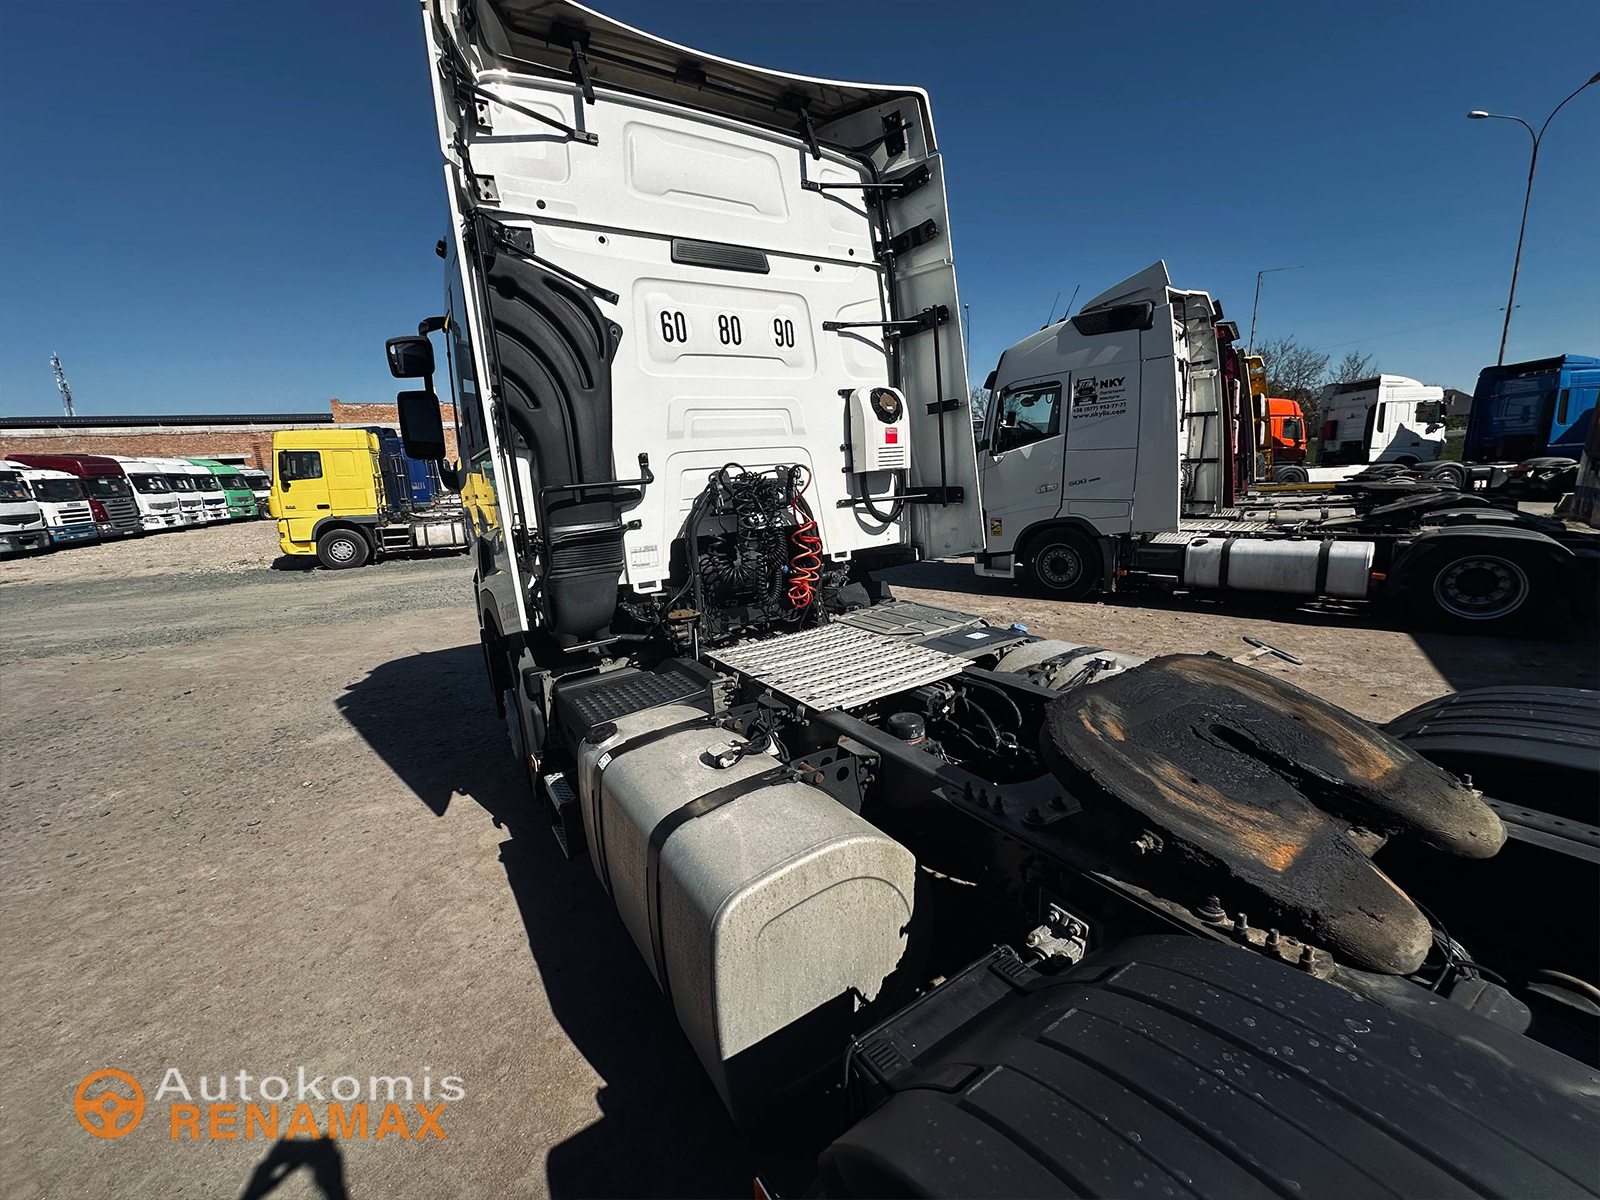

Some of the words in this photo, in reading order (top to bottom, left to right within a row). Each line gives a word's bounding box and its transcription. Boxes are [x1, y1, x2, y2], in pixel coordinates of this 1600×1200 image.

[660, 311, 687, 343] 60
[718, 314, 742, 345] 80
[773, 318, 795, 348] 90
[1100, 376, 1126, 389] NKY
[1068, 478, 1087, 486] 500
